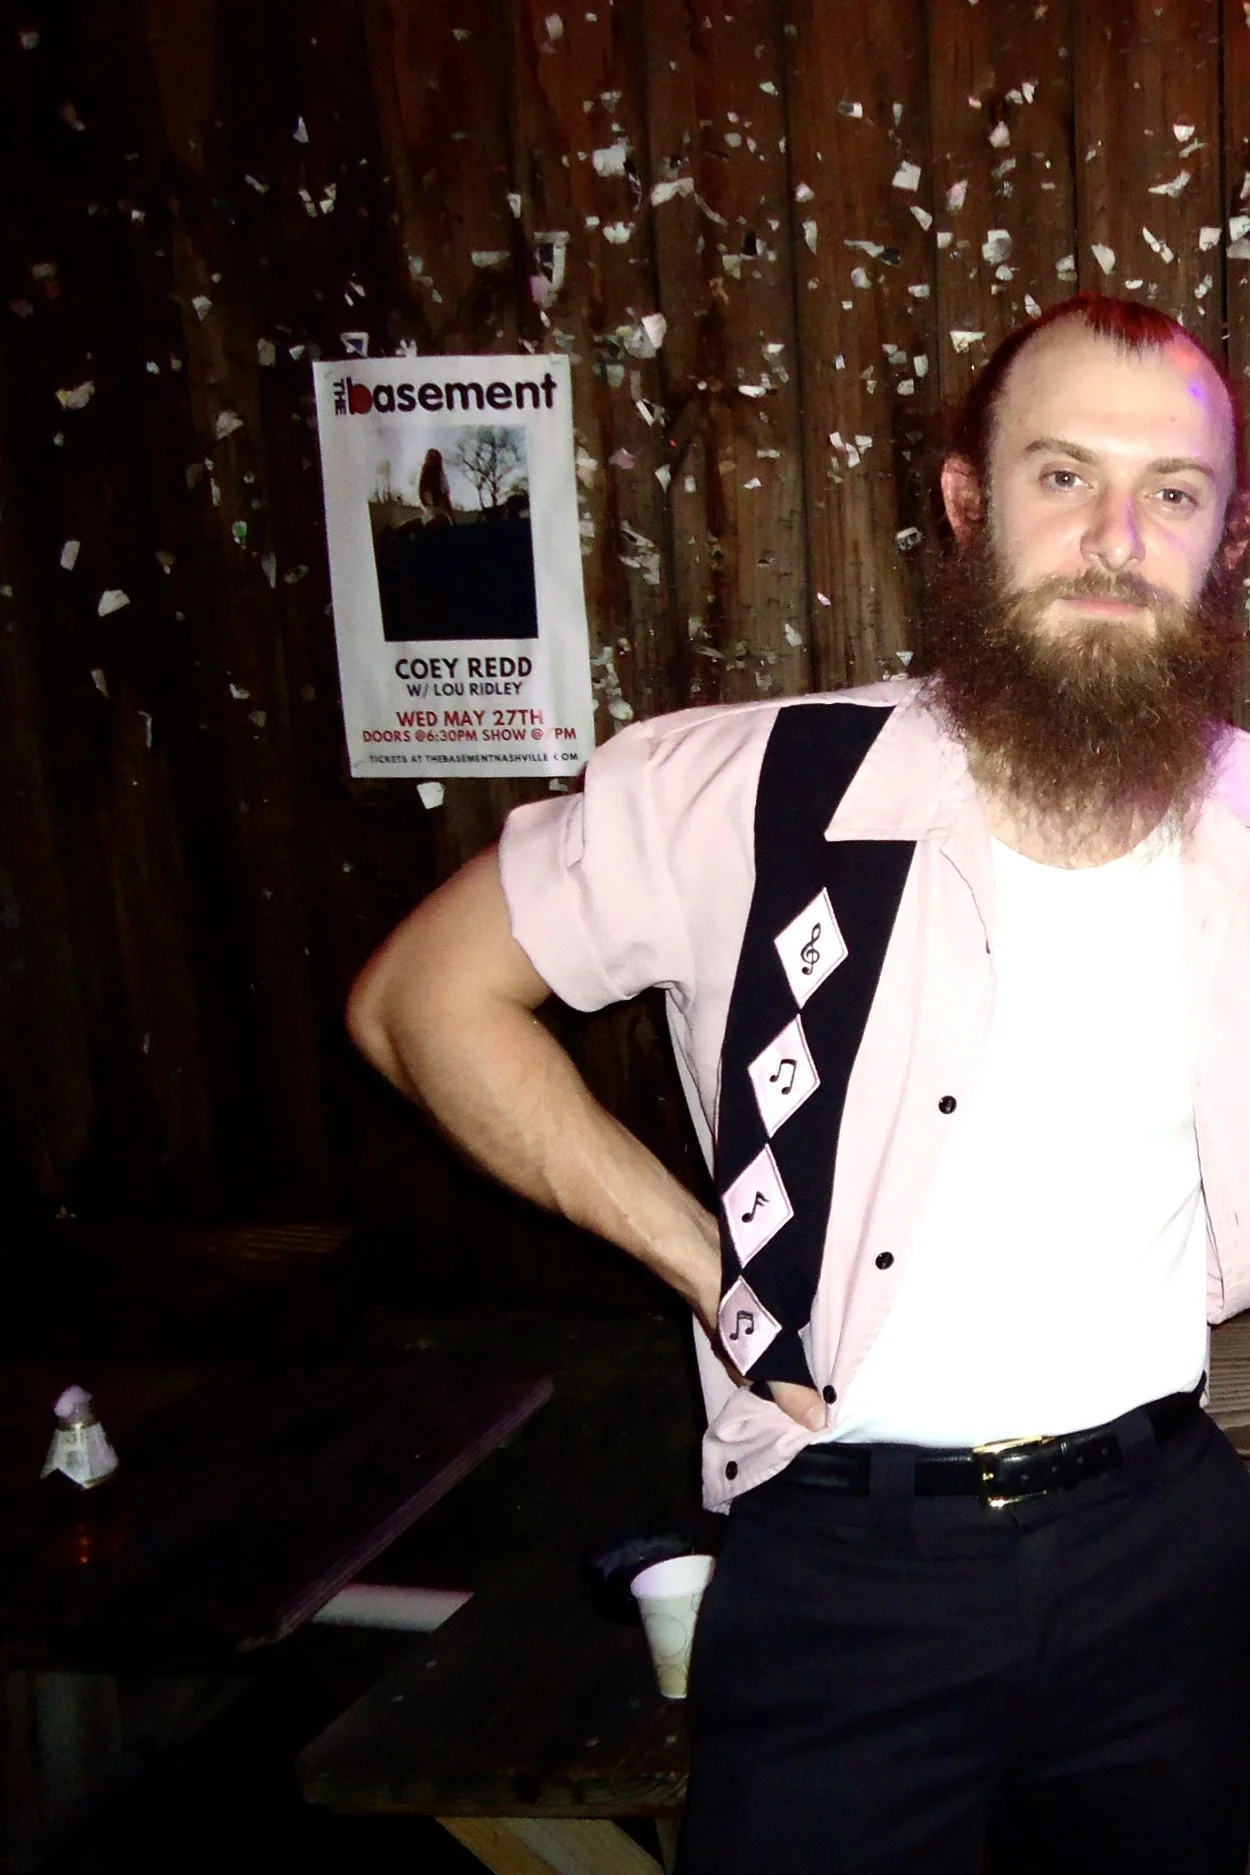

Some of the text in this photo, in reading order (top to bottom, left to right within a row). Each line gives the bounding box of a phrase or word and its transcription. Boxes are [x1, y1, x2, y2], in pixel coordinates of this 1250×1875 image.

[333, 372, 557, 416] THE basement
[395, 657, 532, 680] COEY REDD
[407, 682, 522, 698] W/ LOU RIDLEY
[396, 709, 544, 727] WED MAY 27TH
[363, 731, 411, 743] DOORS
[415, 730, 478, 742] @6:30PM
[483, 729, 526, 741] SHOW
[369, 753, 578, 764] TICKETS AT THEBASEMENTNASHVILLECOM
